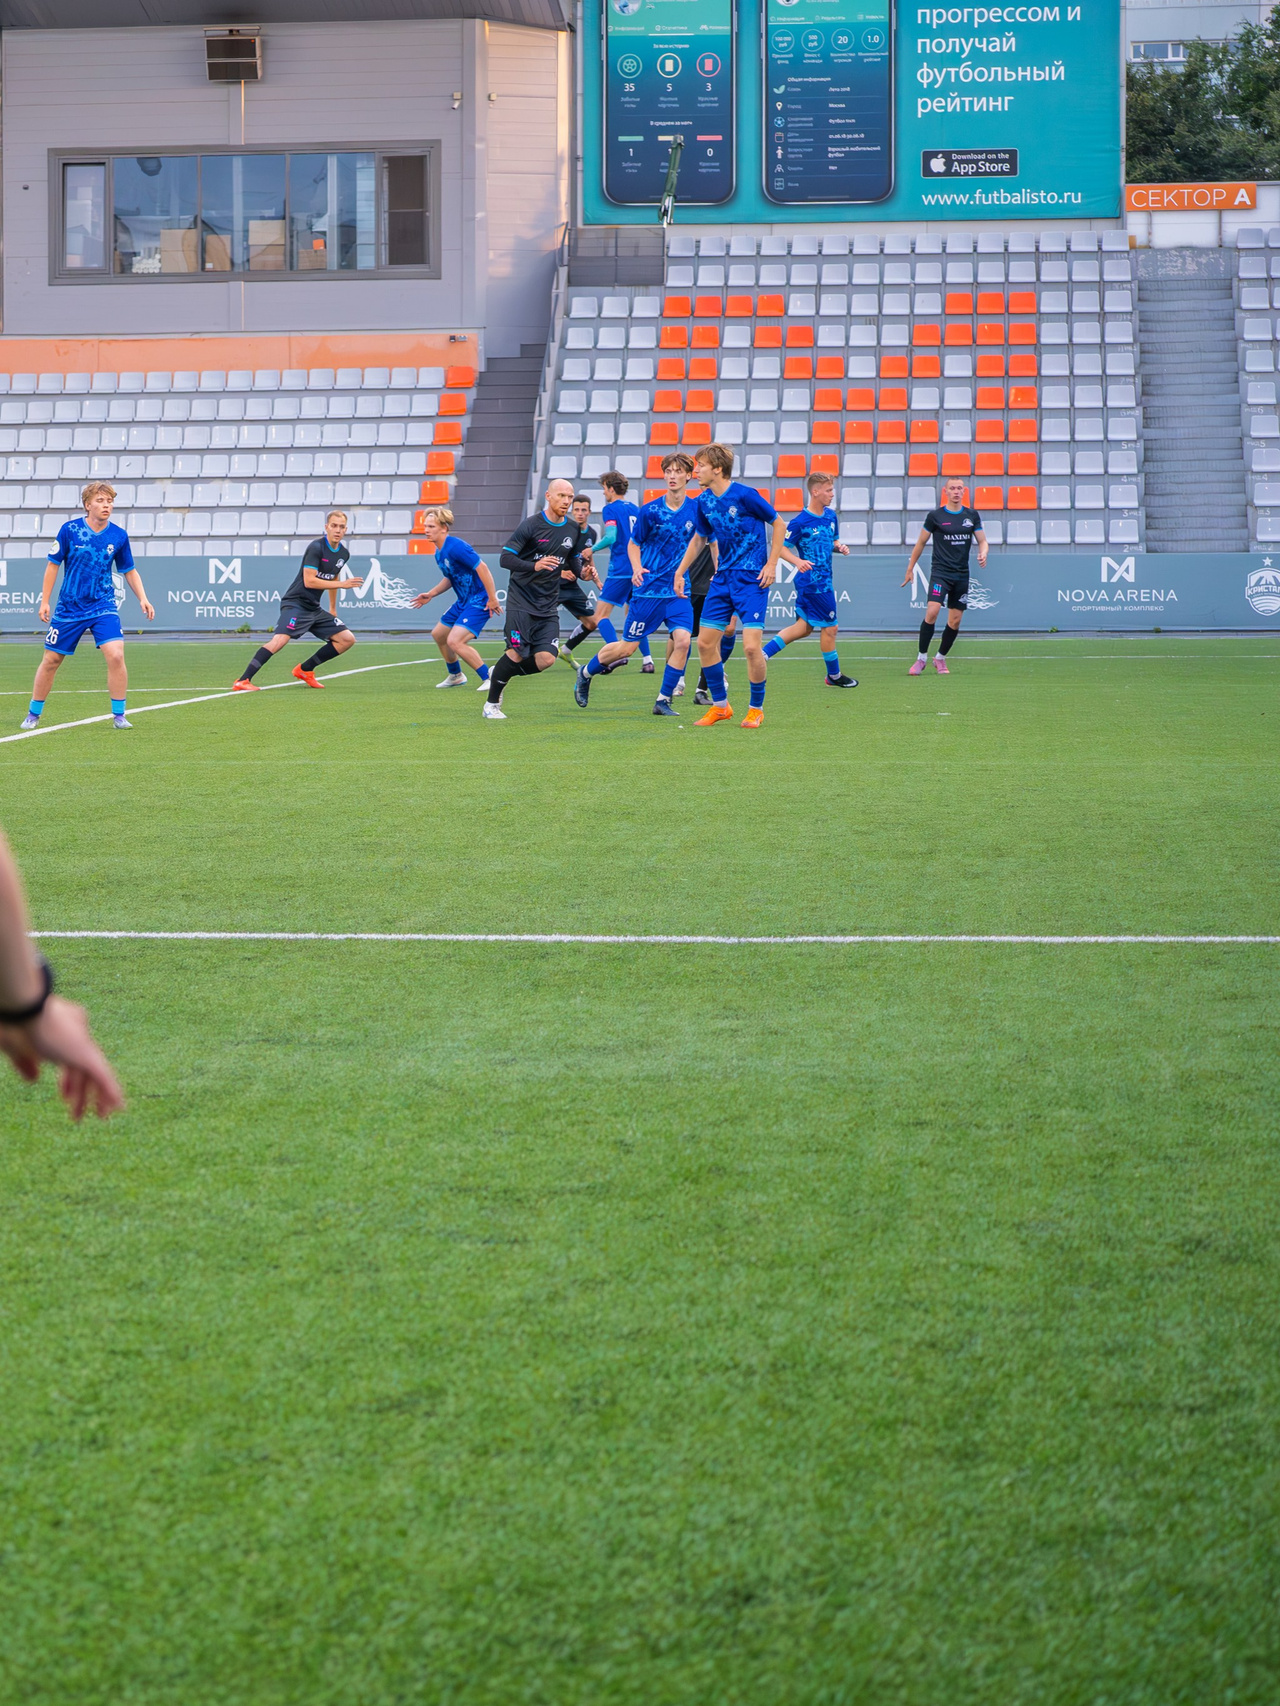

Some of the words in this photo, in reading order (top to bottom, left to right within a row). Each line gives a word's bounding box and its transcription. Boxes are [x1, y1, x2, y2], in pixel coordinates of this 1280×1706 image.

[917, 6, 1061, 29] прогрессом
[1067, 5, 1081, 21] и
[837, 35, 848, 44] 20
[867, 34, 880, 43] 1.0
[917, 31, 1016, 58] получай
[916, 60, 1065, 88] футбольный
[624, 83, 635, 92] 35
[666, 83, 672, 92] 5
[706, 82, 712, 91] 3
[917, 92, 1014, 118] рейтинг
[629, 148, 634, 156] 1
[706, 148, 714, 156] 0
[997, 152, 1010, 160] the
[951, 162, 977, 175] App
[978, 161, 1010, 173] Store
[921, 188, 1082, 206] www.futbalisto.ru
[1131, 189, 1227, 208] СЕКТОР
[1233, 188, 1252, 206] А
[1122, 509, 1129, 518] 3
[1123, 544, 1130, 553] 2
[168, 590, 216, 603] NOVA
[221, 590, 282, 603] ARENA
[1057, 589, 1110, 602] NOVA
[1113, 589, 1178, 602] ARENA
[195, 605, 255, 618] FITNESS
[1071, 604, 1122, 612] СПОРТИВНЫЙ
[46, 625, 60, 645] 26
[628, 621, 646, 637] 42
